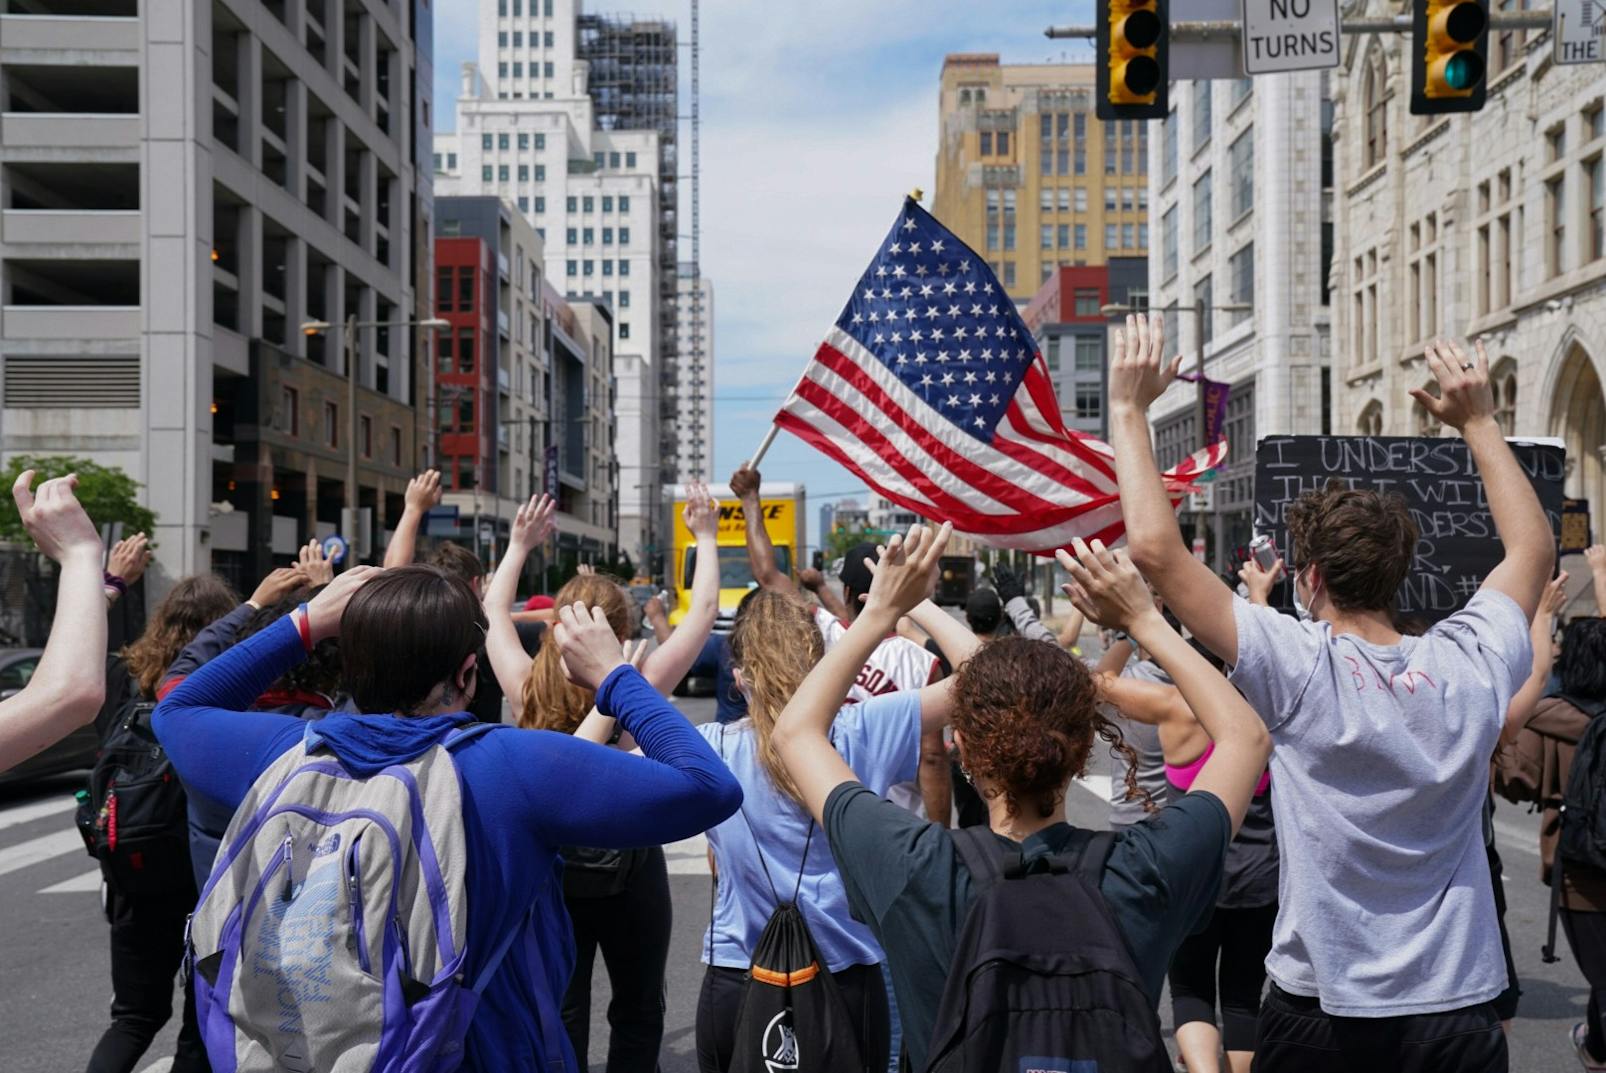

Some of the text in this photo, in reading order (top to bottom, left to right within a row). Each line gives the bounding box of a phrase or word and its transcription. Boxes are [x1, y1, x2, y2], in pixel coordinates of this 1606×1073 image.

[1270, 0, 1309, 20] NO
[1250, 31, 1333, 59] TURNS
[1561, 40, 1598, 60] THE
[1265, 436, 1564, 481] I UNDERSTND
[1406, 478, 1489, 508] WIL
